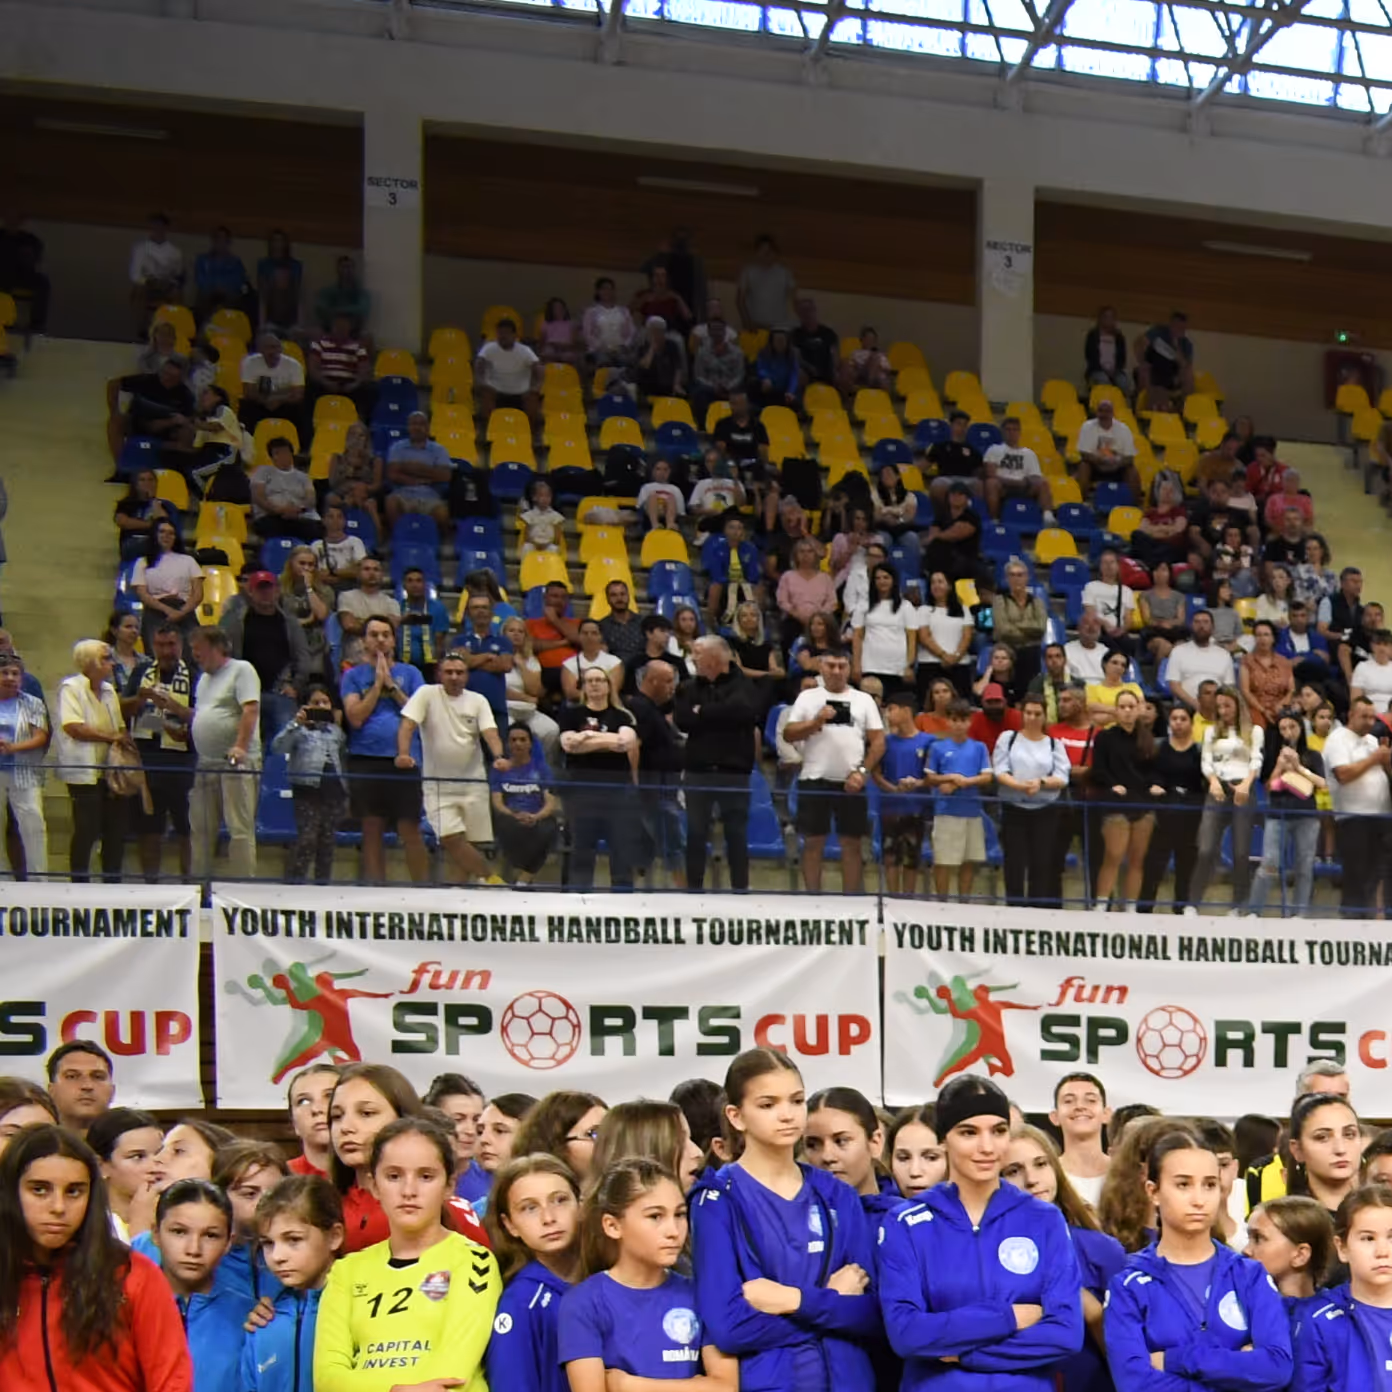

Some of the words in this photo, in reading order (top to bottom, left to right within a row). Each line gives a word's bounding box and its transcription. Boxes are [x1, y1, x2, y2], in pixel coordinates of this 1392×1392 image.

[367, 176, 419, 191] SECTOR
[388, 192, 397, 205] 3
[222, 907, 317, 937] YOUTH
[326, 911, 540, 943] INTERNATIONAL
[548, 916, 686, 945] HANDBALL
[692, 917, 870, 947] TOURNAMENT
[893, 922, 976, 953] YOUTH
[983, 927, 1173, 962] INTERNATIONAL
[1179, 935, 1299, 965] HANDBALL
[399, 960, 492, 995] fun
[1048, 976, 1129, 1007] fun
[61, 1009, 191, 1056] CUP
[754, 1013, 871, 1056] CUP
[366, 1287, 413, 1318] 12
[366, 1339, 432, 1354] CAPITAL
[362, 1356, 420, 1370] INVEST
